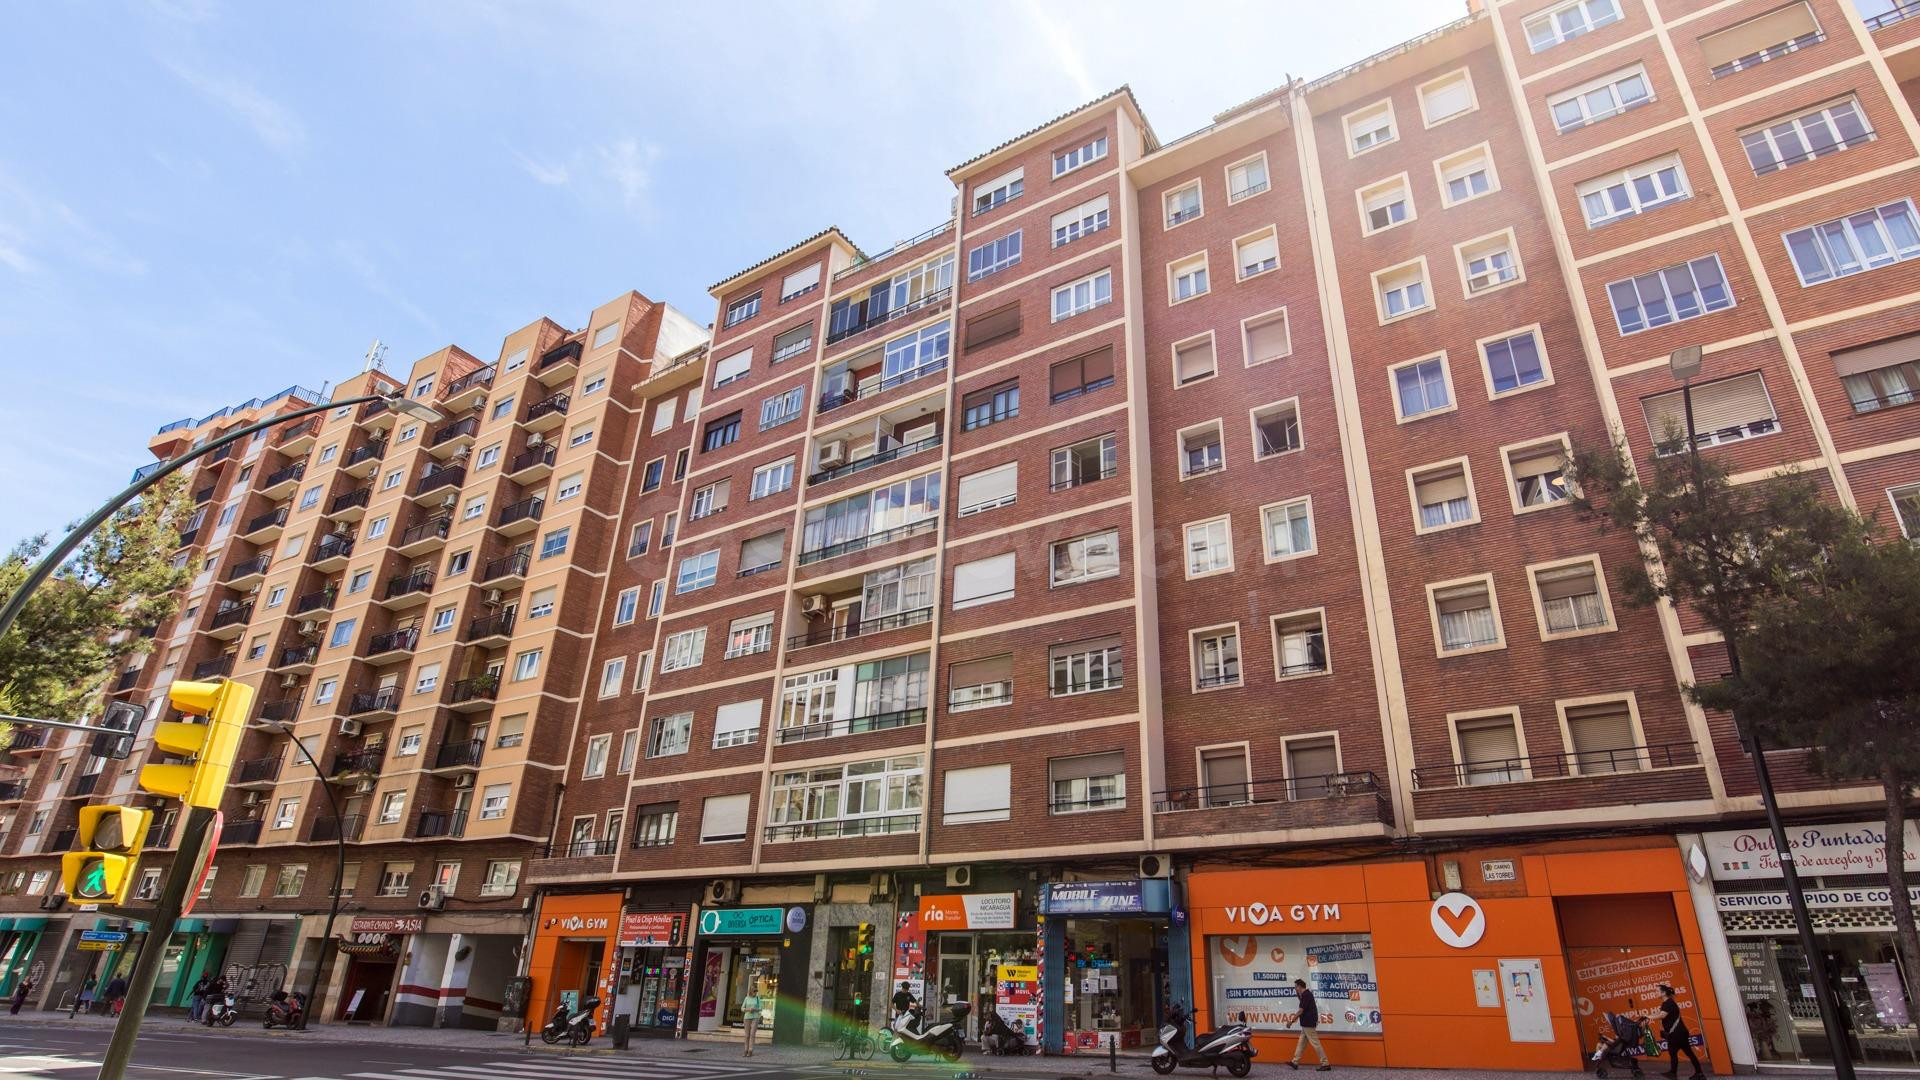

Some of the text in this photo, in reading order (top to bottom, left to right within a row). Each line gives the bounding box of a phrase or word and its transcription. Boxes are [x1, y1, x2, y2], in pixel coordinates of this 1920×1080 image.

[1734, 829, 1886, 852] Dules Puntada
[1759, 853, 1799, 869] Tiea
[1800, 854, 1813, 867] de
[1815, 850, 1863, 870] arreglos
[1864, 854, 1874, 869] y
[1496, 871, 1514, 879] TORRES
[1051, 889, 1099, 901] MOBILE
[1100, 894, 1138, 907] ZONE
[1719, 895, 1782, 907] SERVICIO
[1786, 892, 1843, 905] RPIDO
[1843, 892, 1864, 903] DE
[924, 904, 944, 921] ria
[1224, 902, 1341, 926] VIVA GYM
[404, 919, 422, 931] ASIA
[586, 918, 608, 929] GYM
[1308, 944, 1335, 955] AMPLIO
[1580, 970, 1598, 979] SIN
[1599, 952, 1677, 975] PERMANENCIA
[1312, 973, 1333, 981] GRAN
[1587, 970, 1674, 994] CON GRAN VARIEDAD
[1329, 982, 1376, 991] ACTIVIDADES
[1313, 990, 1350, 999] DIRIGIDAS
[1600, 991, 1612, 1000] DE
